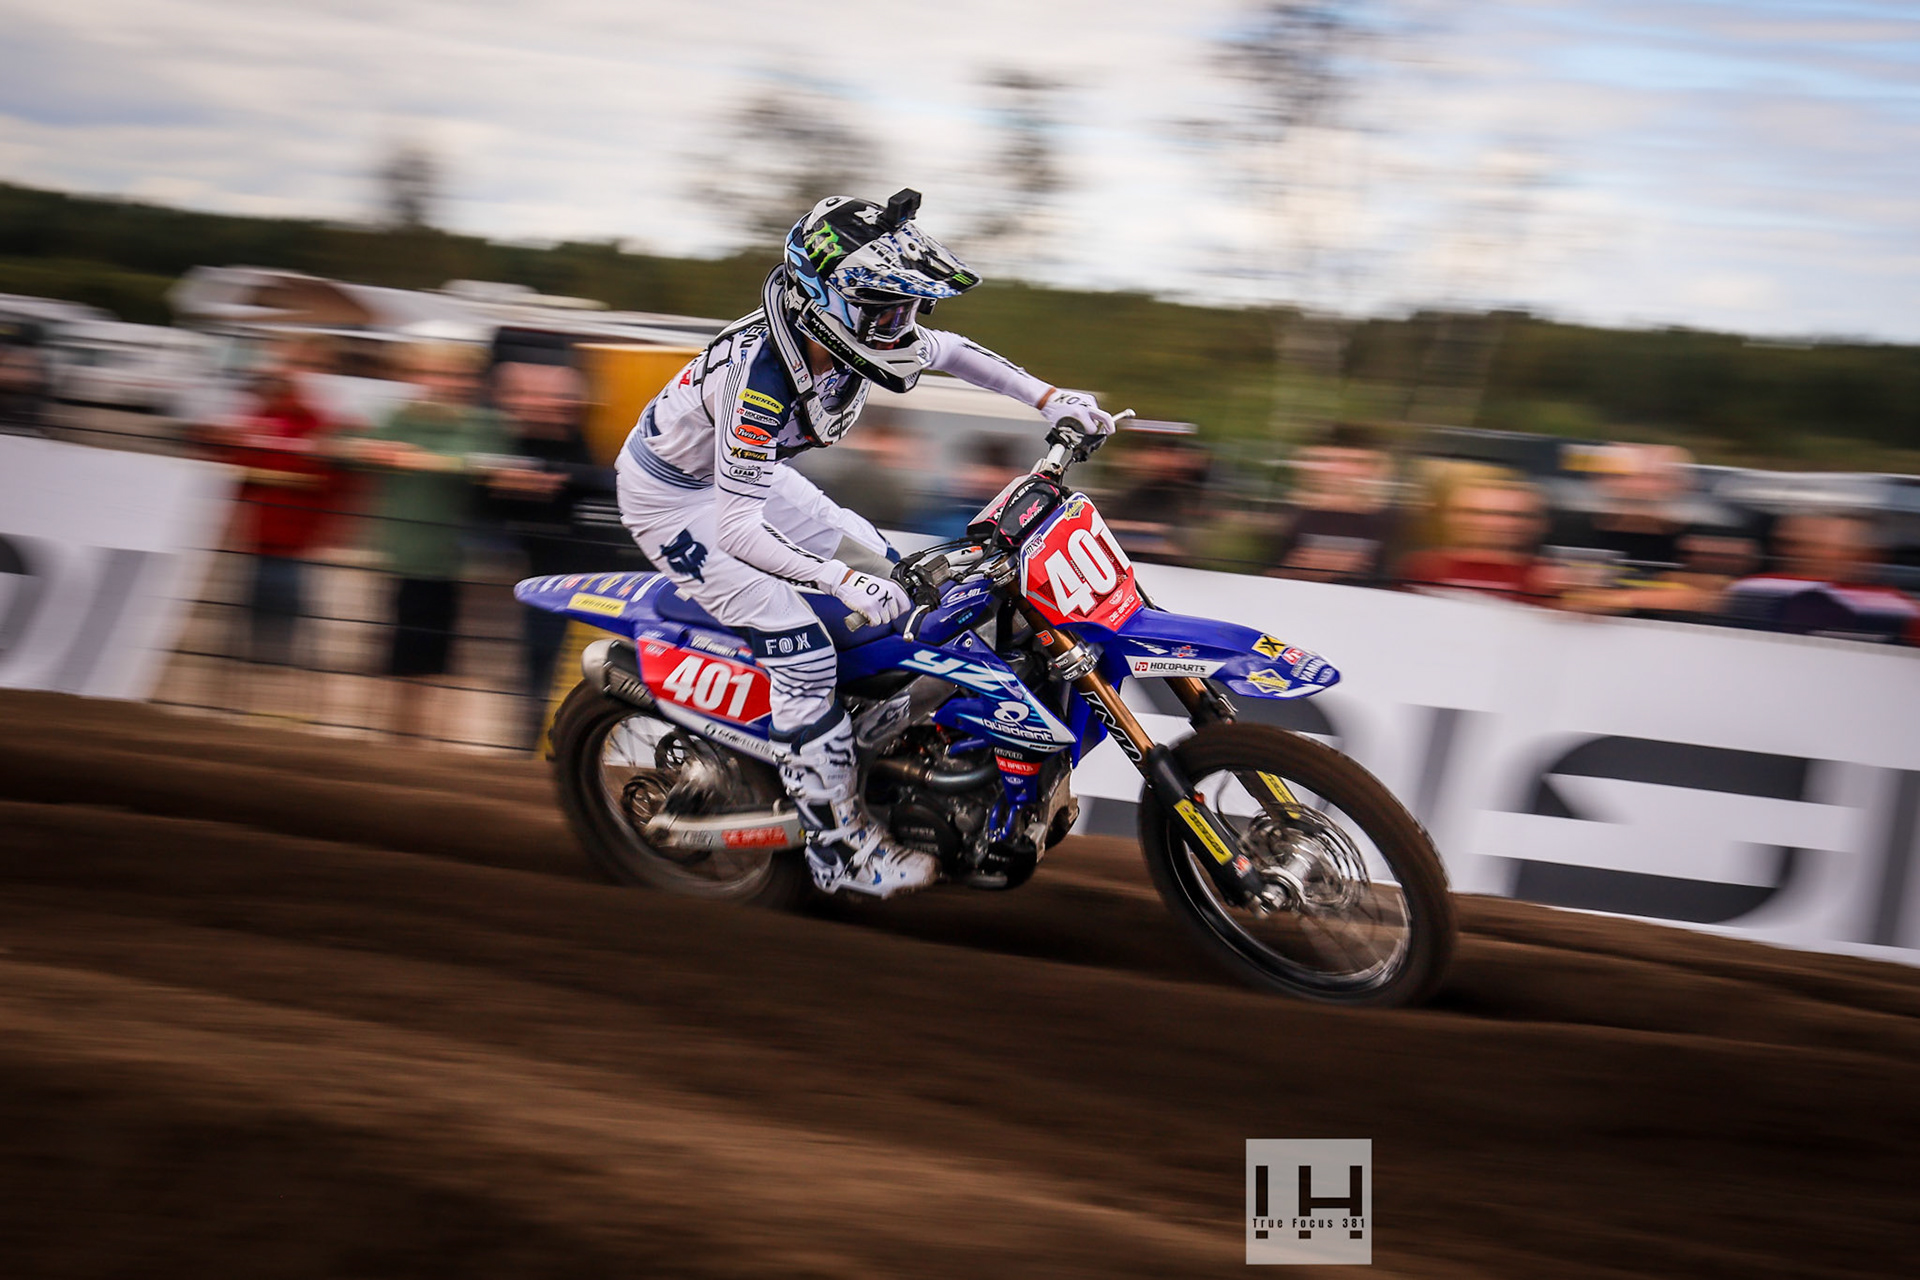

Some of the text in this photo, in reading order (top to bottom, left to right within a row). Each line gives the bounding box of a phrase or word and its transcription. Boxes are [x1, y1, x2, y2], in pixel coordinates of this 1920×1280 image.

[811, 317, 853, 355] MONSTER
[738, 428, 769, 442] Twin Air
[733, 468, 755, 477] AFAM
[1044, 508, 1131, 618] 401
[854, 574, 893, 609] FOX
[765, 632, 811, 655] FOX
[1149, 662, 1207, 673] HOCOPARTS
[662, 654, 756, 719] 401
[983, 718, 1054, 743] quadrant
